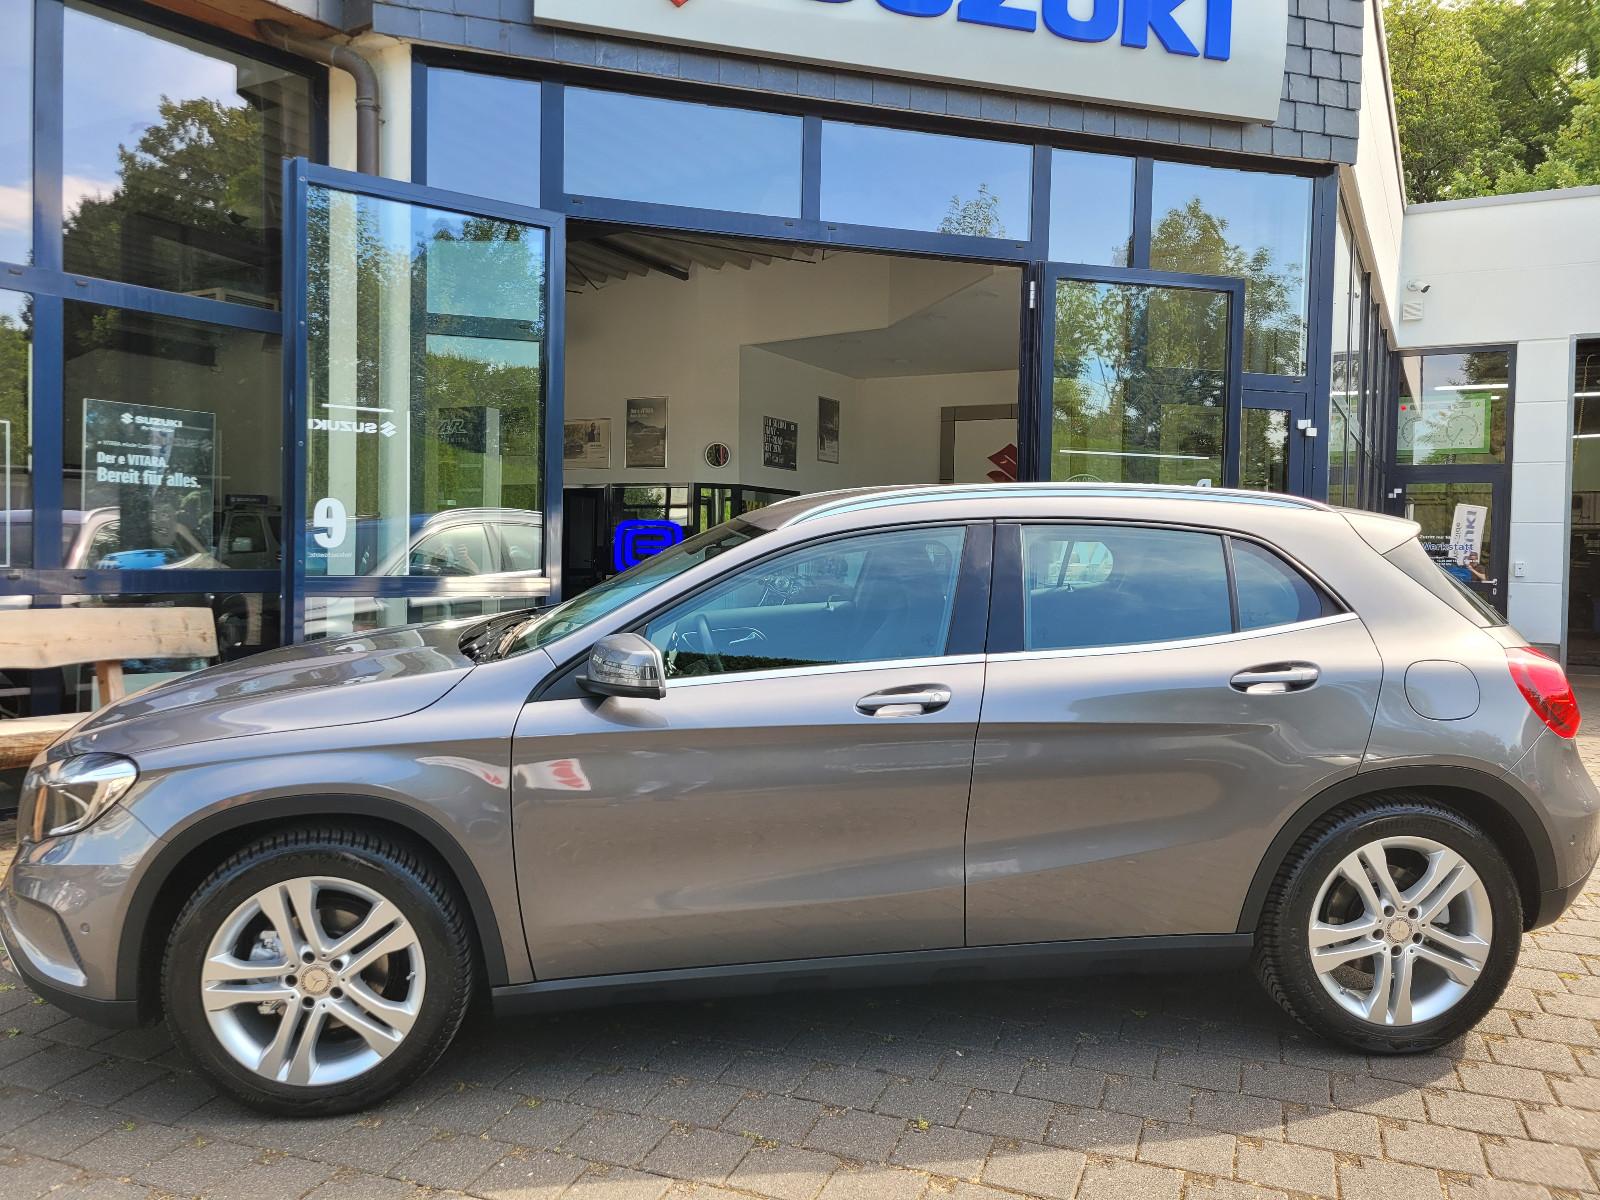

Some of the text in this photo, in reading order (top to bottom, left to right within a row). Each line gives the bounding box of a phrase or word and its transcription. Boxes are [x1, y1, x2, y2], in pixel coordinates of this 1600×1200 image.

[813, 0, 1232, 61] UKI
[134, 415, 183, 428] SUZUKI
[97, 451, 169, 468] Der e VITARA.
[97, 466, 201, 488] Bereit für alles.
[1421, 541, 1474, 551] Werkstatt
